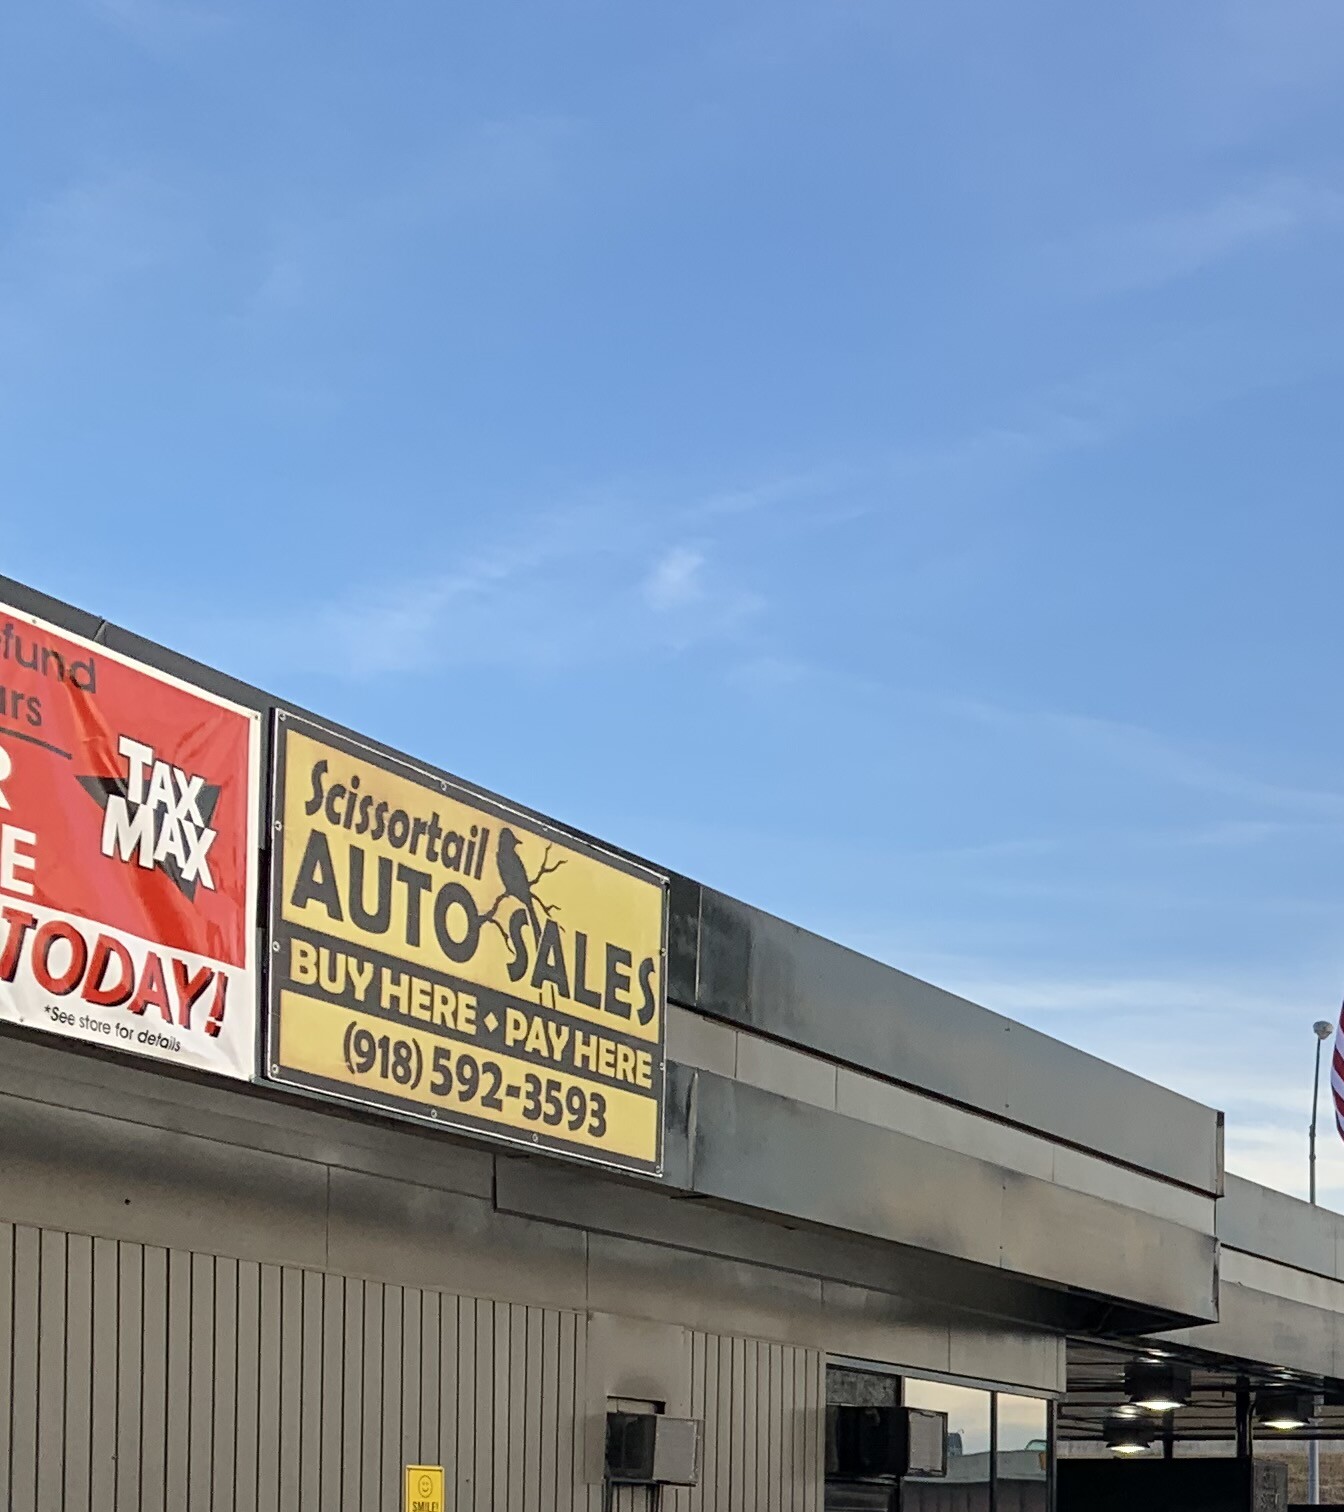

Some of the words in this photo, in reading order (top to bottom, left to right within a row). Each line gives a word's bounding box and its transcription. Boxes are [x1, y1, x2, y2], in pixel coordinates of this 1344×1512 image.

[117, 733, 206, 829] TAX
[305, 759, 490, 881] Scissortail
[101, 793, 217, 892] MAX
[0, 906, 229, 1038] TODAY!
[290, 829, 480, 963] AUTO
[506, 906, 656, 1026] SALES
[78, 1015, 111, 1035] store
[114, 1022, 135, 1041] for
[137, 1028, 181, 1053] details
[290, 938, 375, 1001] BUY
[380, 967, 478, 1036] HERE
[505, 1008, 573, 1062] PAY
[573, 1036, 653, 1090] HERE
[343, 1020, 422, 1091] (918)
[430, 1046, 607, 1138] 592-3593
